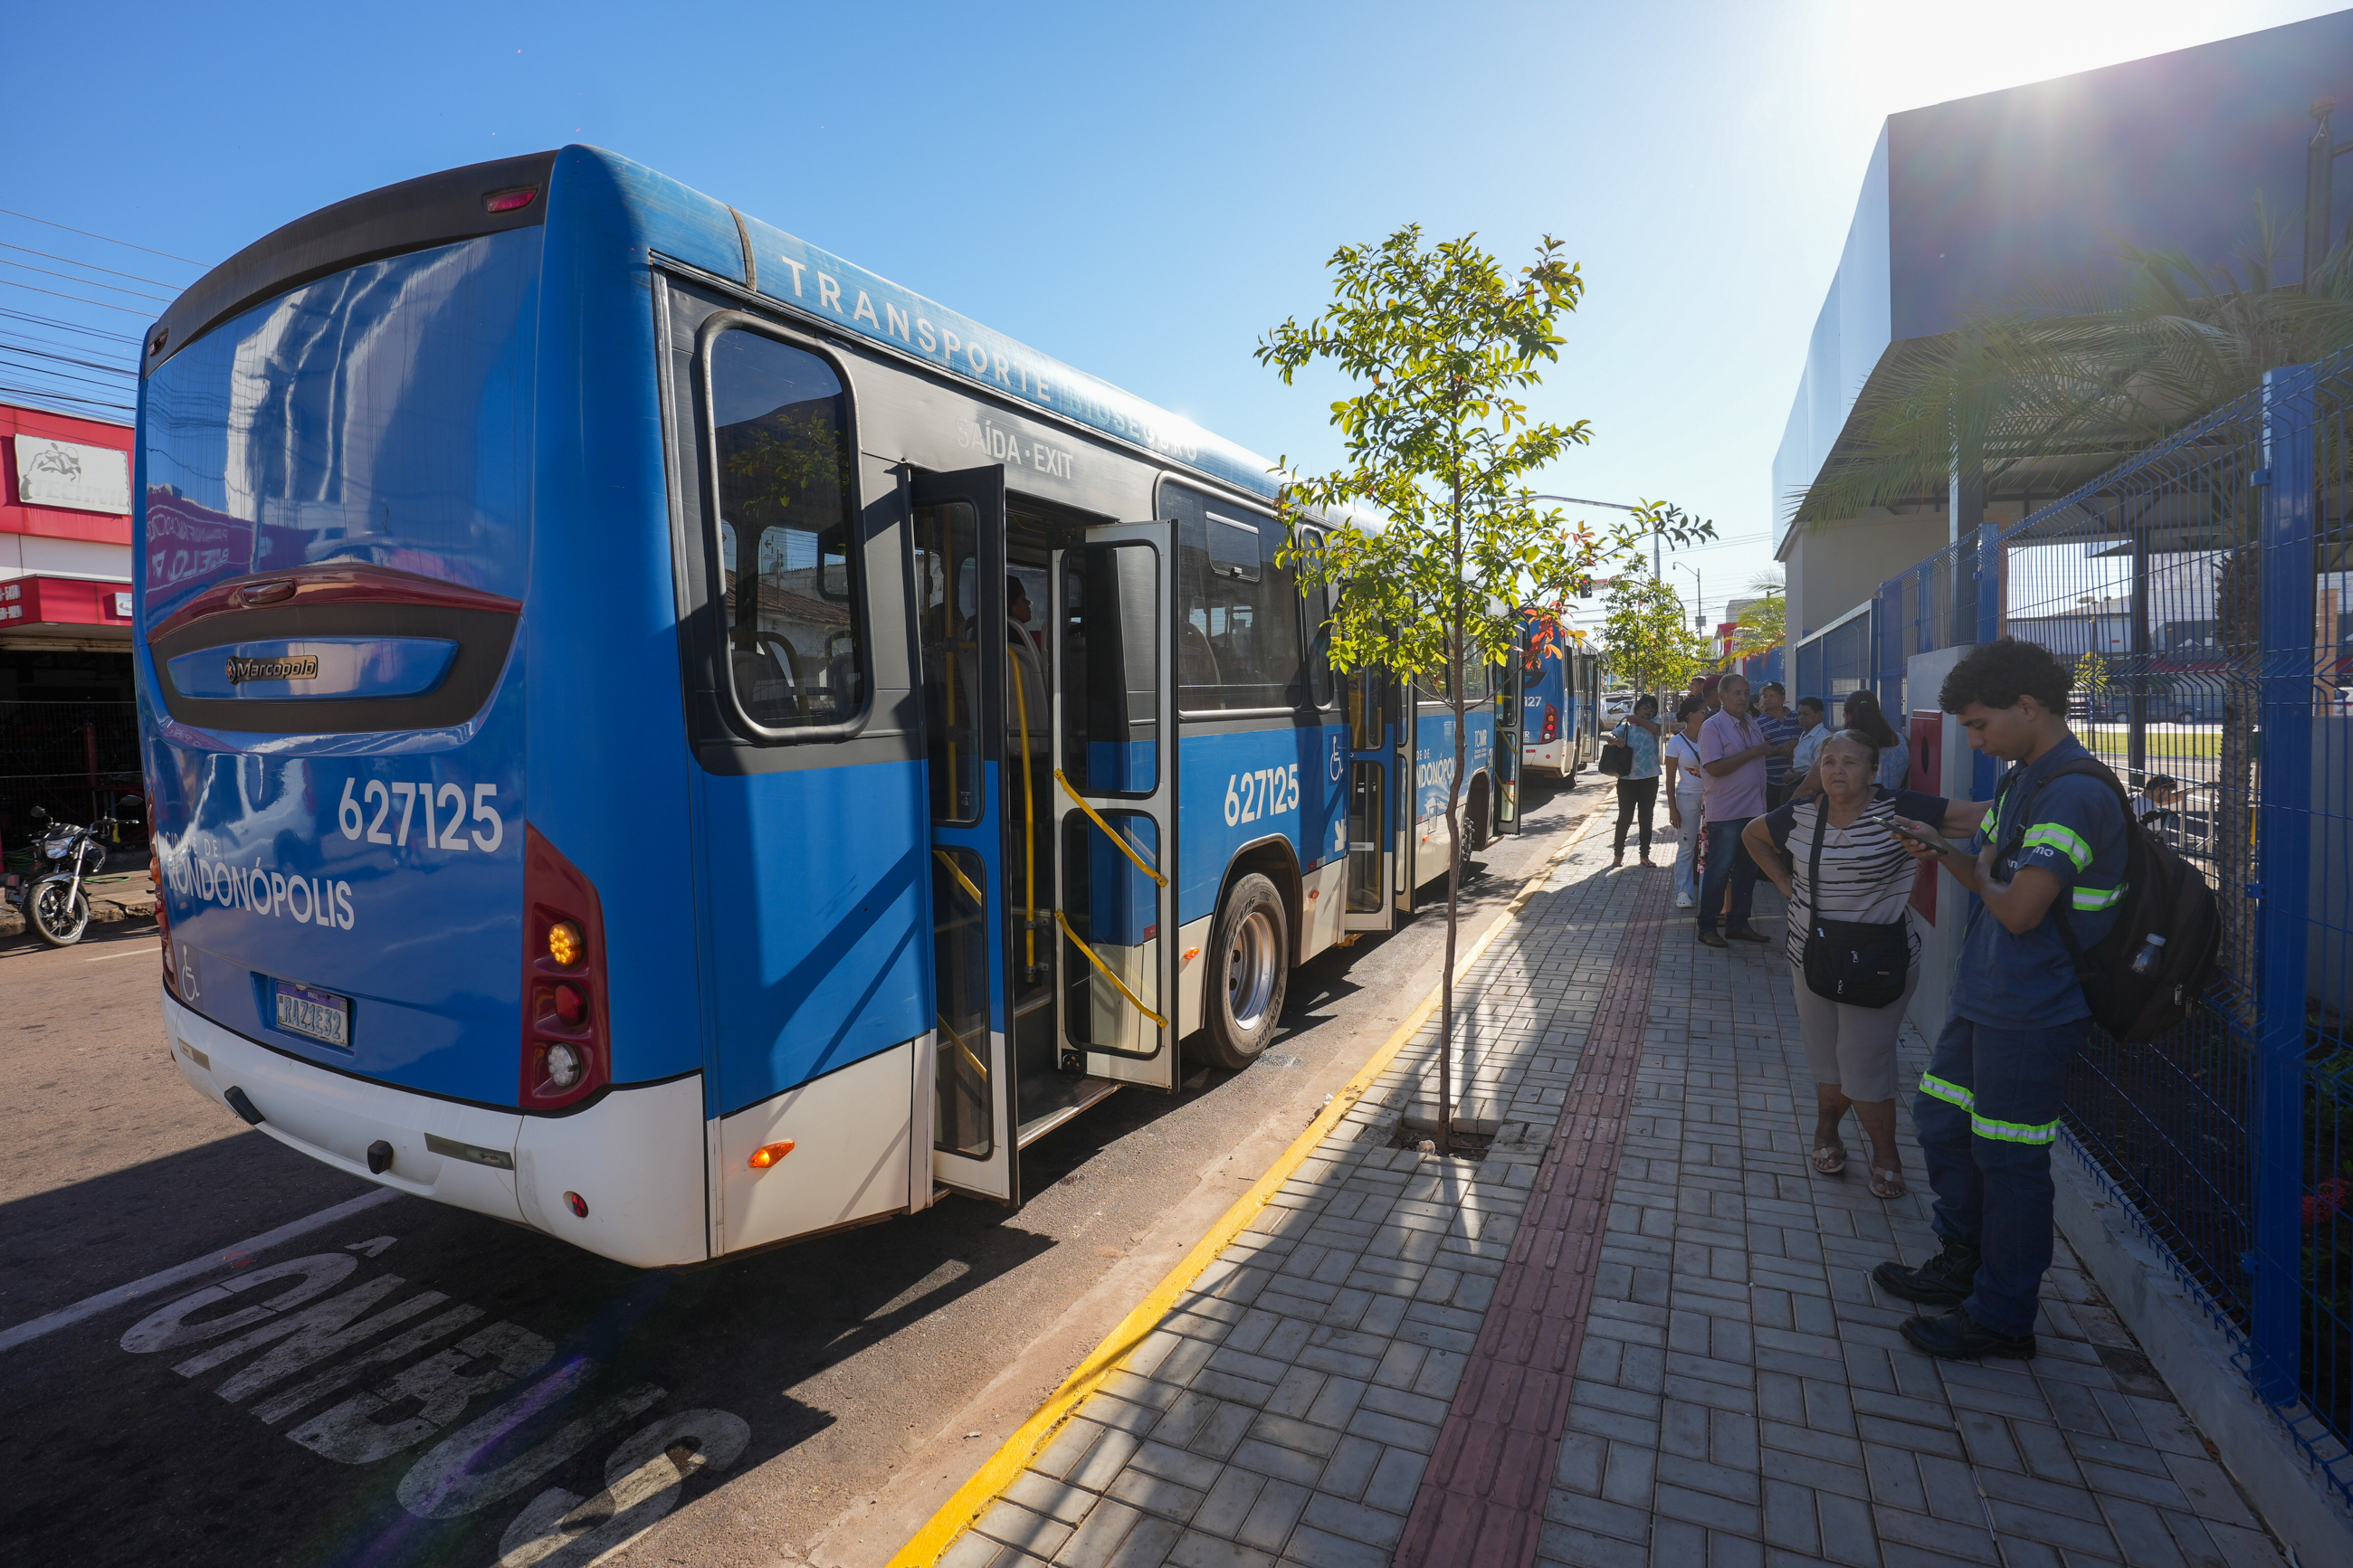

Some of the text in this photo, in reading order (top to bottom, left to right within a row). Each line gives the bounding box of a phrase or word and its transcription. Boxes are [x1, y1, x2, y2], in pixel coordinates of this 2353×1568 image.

[780, 254, 1052, 403] TRANSPORTE
[955, 416, 1073, 480] SAÍDA EXIT
[237, 659, 317, 679] Marcopolo
[1524, 696, 1542, 708] 127
[1224, 763, 1300, 827] 627125
[1416, 752, 1455, 789] NDONÓPOL
[338, 776, 504, 853] 627125
[204, 838, 219, 858] DE
[167, 855, 355, 931] RONDONÓPOLIS
[283, 996, 341, 1040] RAZ1E32
[119, 1234, 752, 1568] ÔNIBUS
